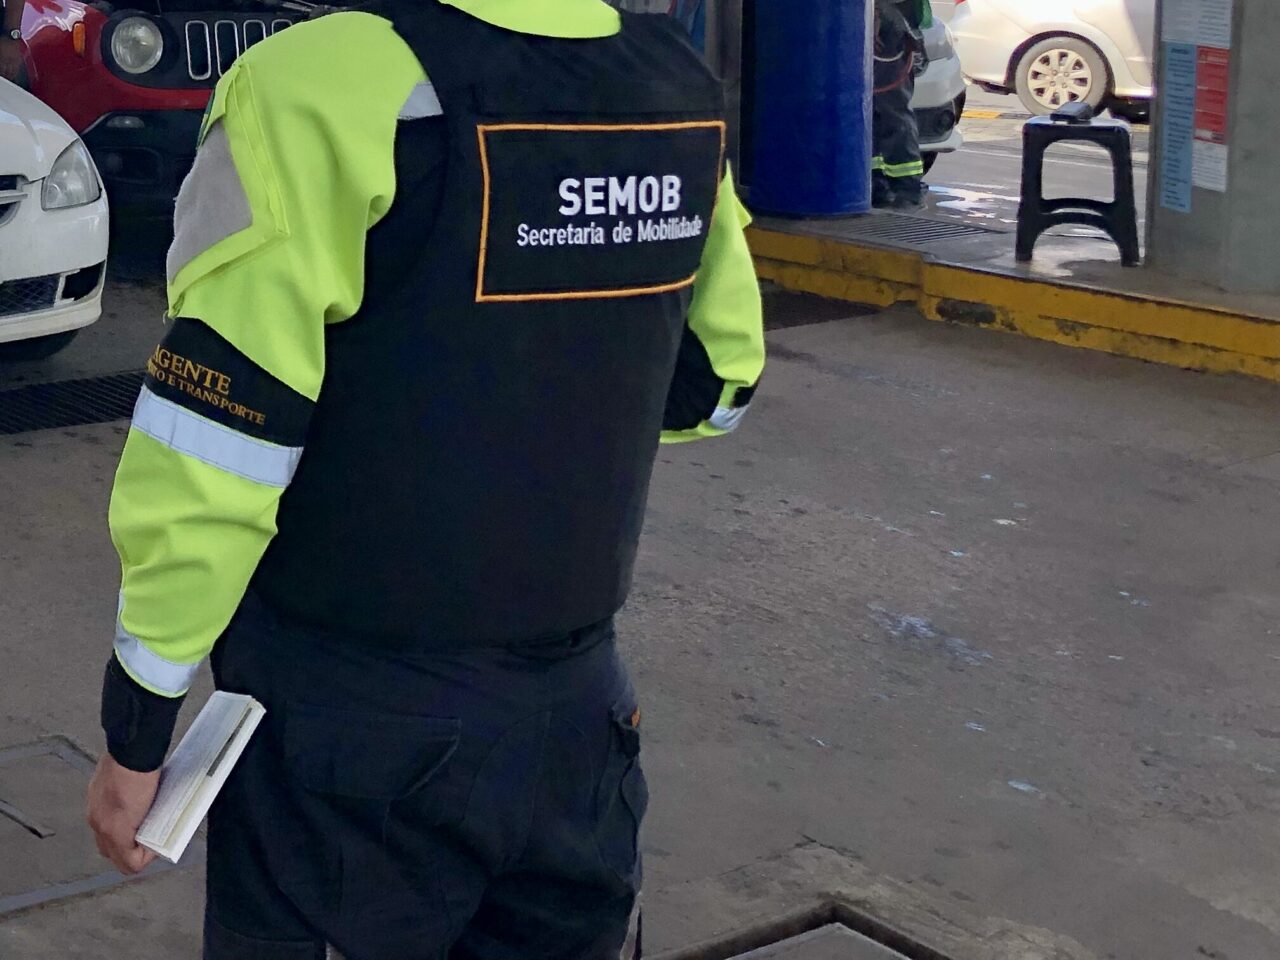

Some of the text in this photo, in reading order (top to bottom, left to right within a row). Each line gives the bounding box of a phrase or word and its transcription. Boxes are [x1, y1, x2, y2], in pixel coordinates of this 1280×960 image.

[558, 175, 681, 216] SEMOB
[516, 214, 703, 247] Secretaria de Mobilidade
[176, 378, 266, 426] TRANSPORTE
